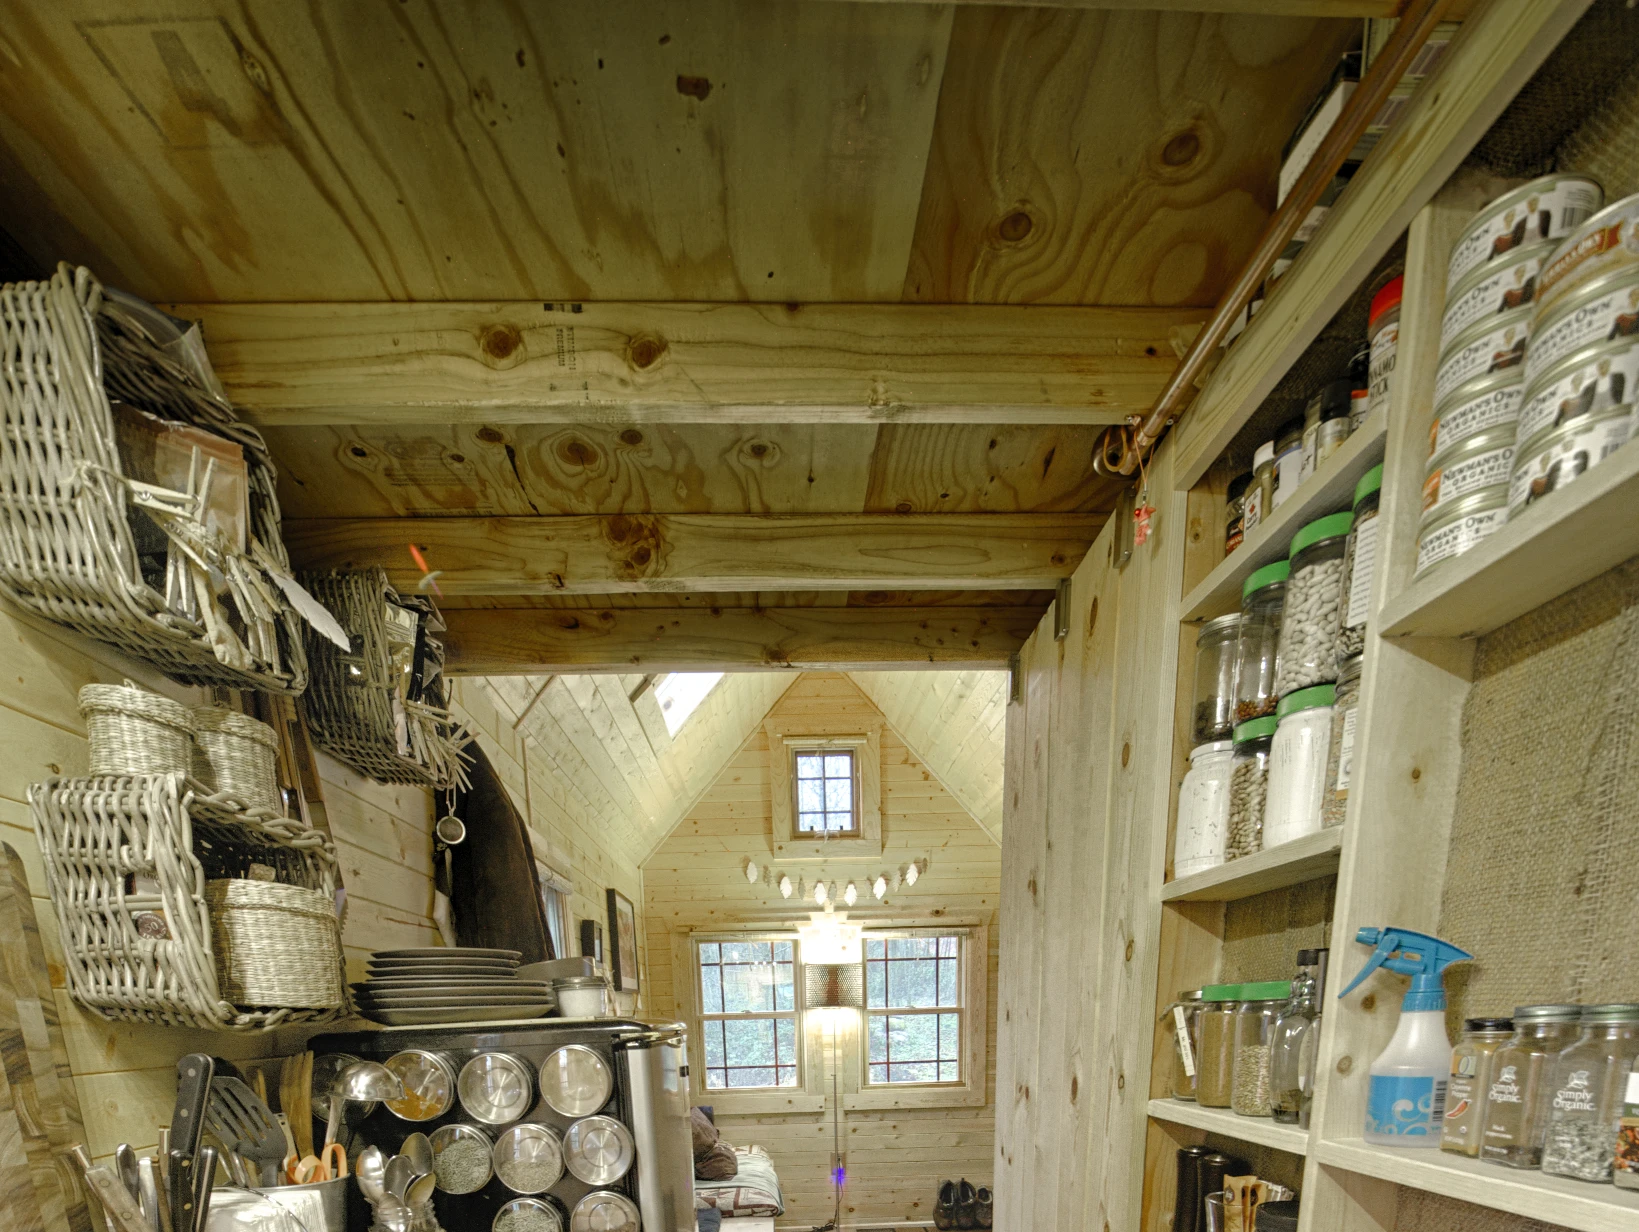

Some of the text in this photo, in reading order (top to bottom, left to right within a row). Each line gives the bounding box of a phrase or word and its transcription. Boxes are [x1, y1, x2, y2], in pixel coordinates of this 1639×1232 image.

[1440, 398, 1491, 428] NEWMAN'S
[1443, 454, 1499, 481] NEWMAN'S
[144, 921, 159, 932] 50
